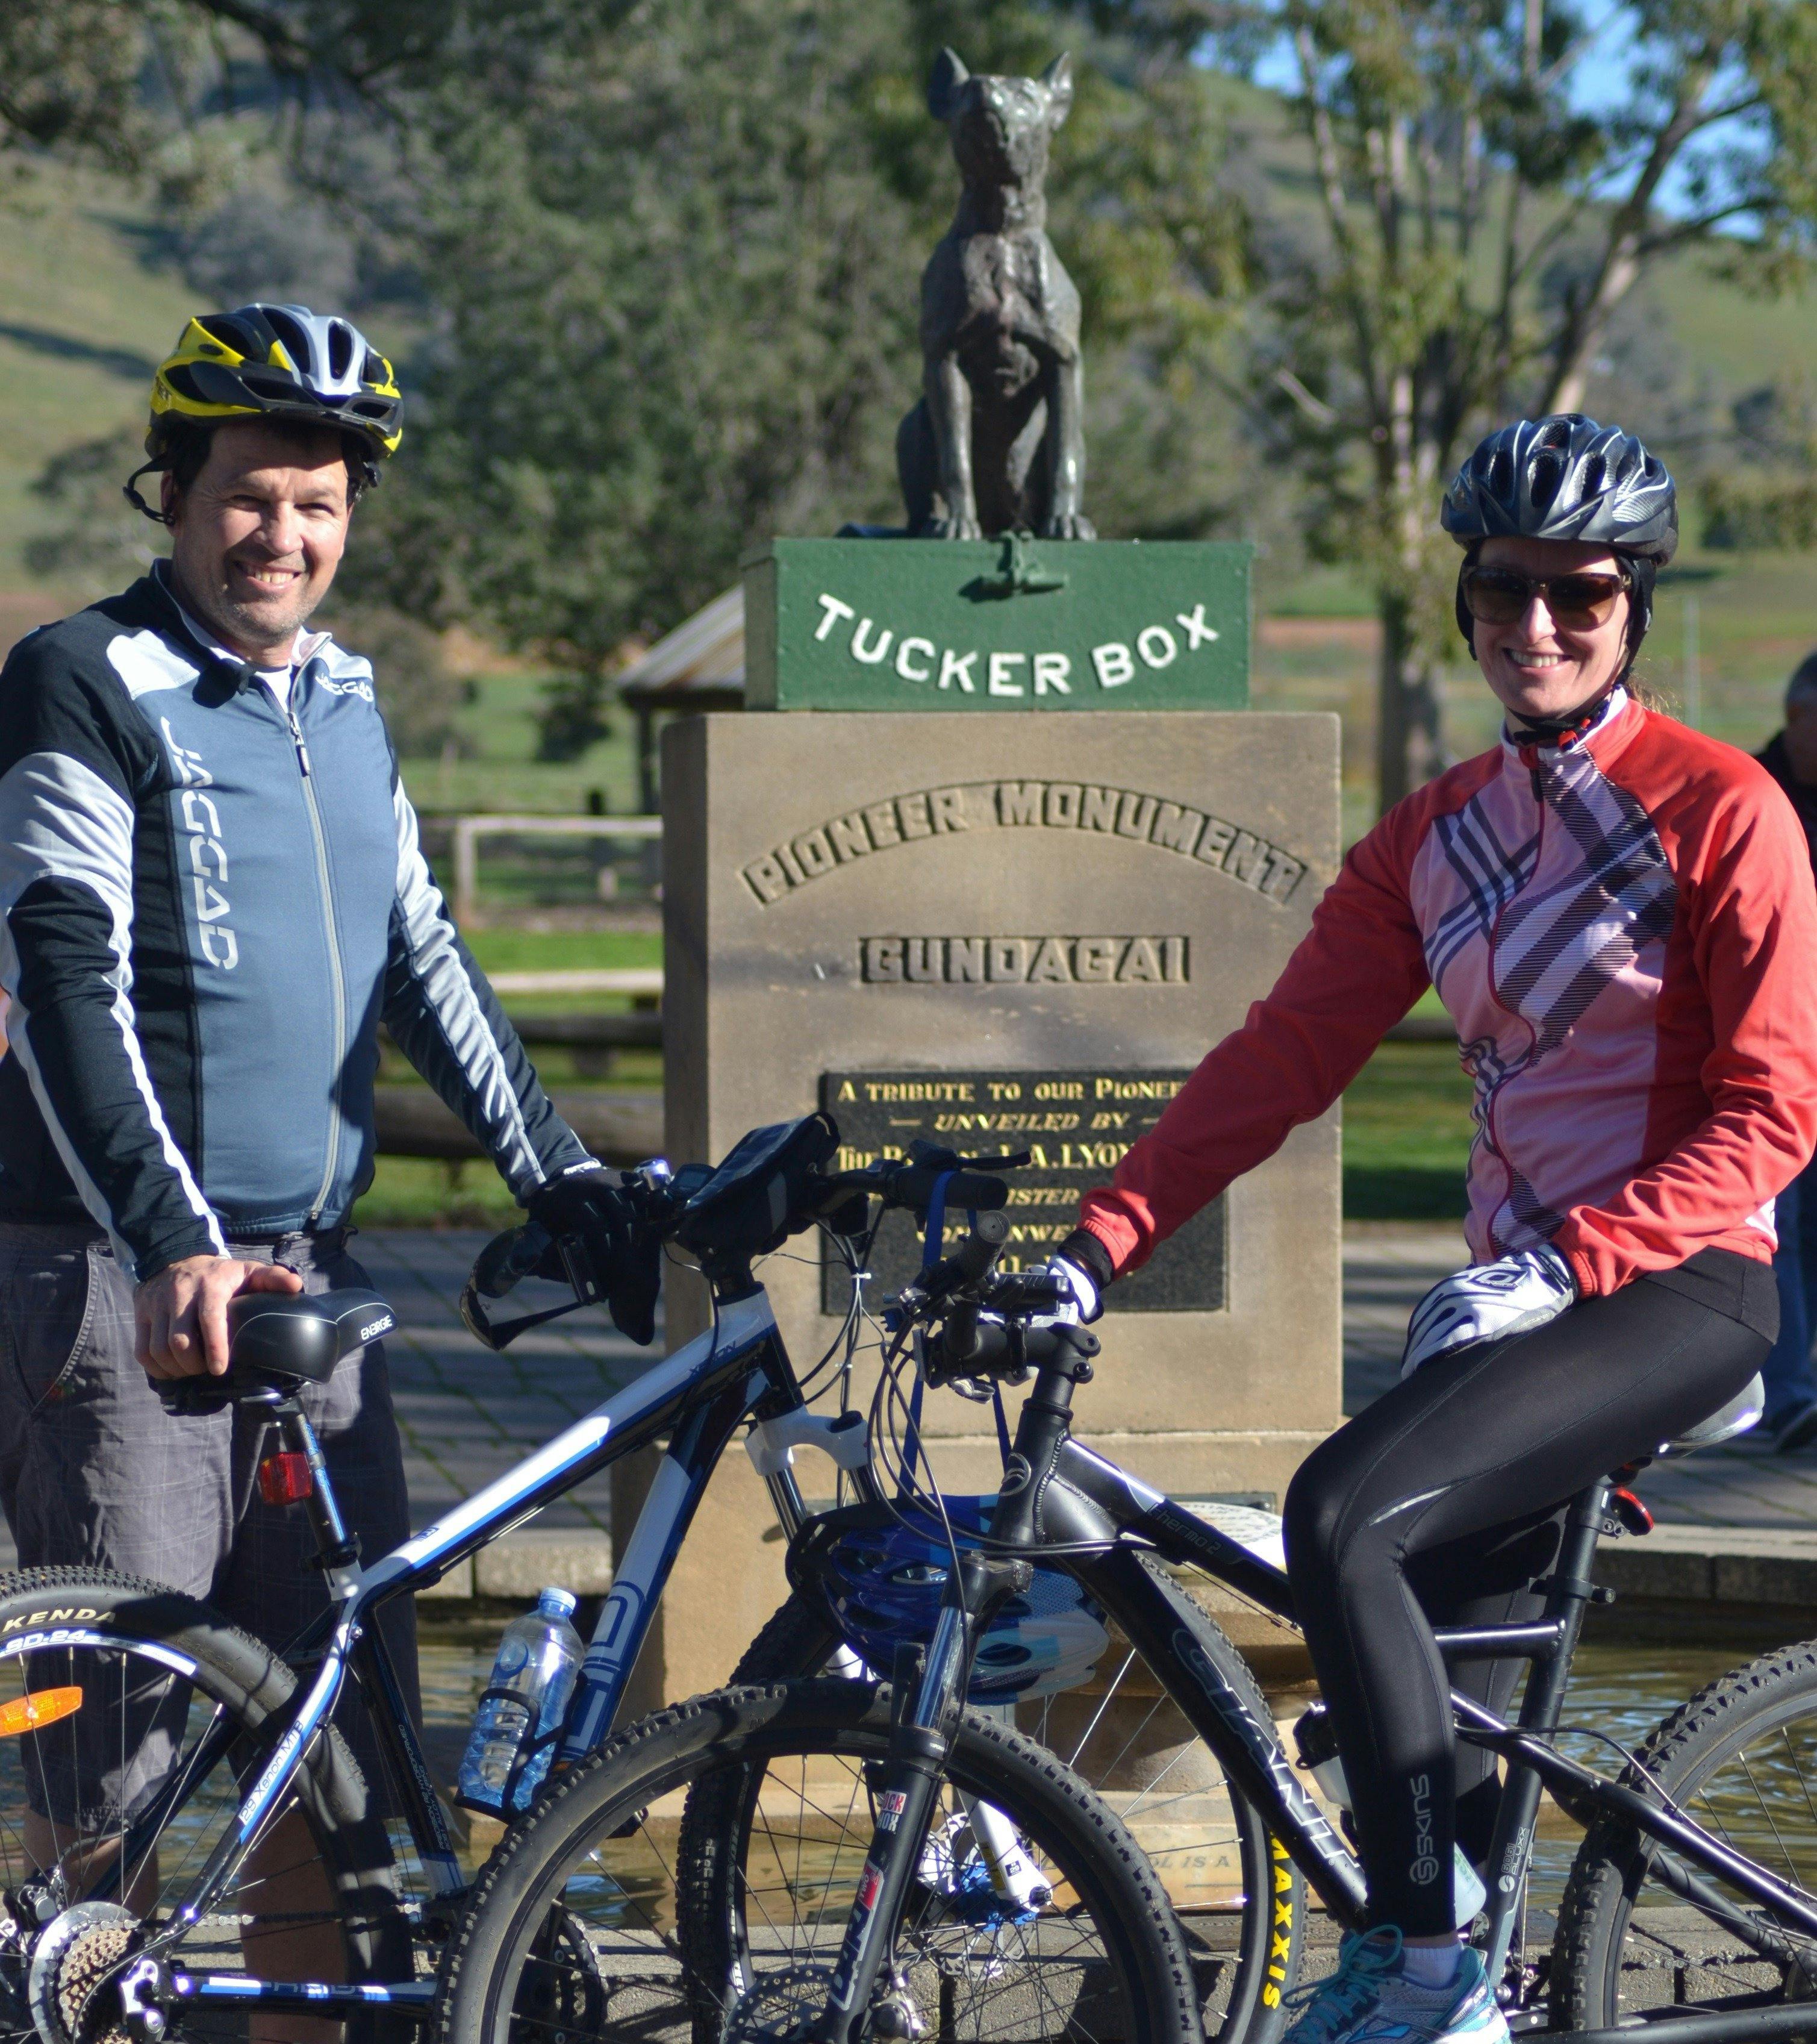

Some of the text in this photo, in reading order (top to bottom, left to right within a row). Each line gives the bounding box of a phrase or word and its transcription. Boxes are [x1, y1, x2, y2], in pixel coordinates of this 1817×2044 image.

[814, 593, 1219, 697] TUCKER BOX
[742, 780, 1309, 907] PIONEER MONUMENT
[861, 936, 1190, 984] GUNDAGAI
[838, 1081, 856, 1102] A
[864, 1082, 976, 1103] TRIBUTE
[987, 1082, 1021, 1101] TO
[1033, 1082, 1083, 1101] OUR
[935, 1112, 1130, 1133] UNVEILED BY
[2, 1608, 116, 1633] KENDA
[240, 1719, 305, 1823] 29 Xenon MTB
[1174, 1628, 1359, 1866] GIANT
[1264, 1838, 1292, 2010] MAXXIS
